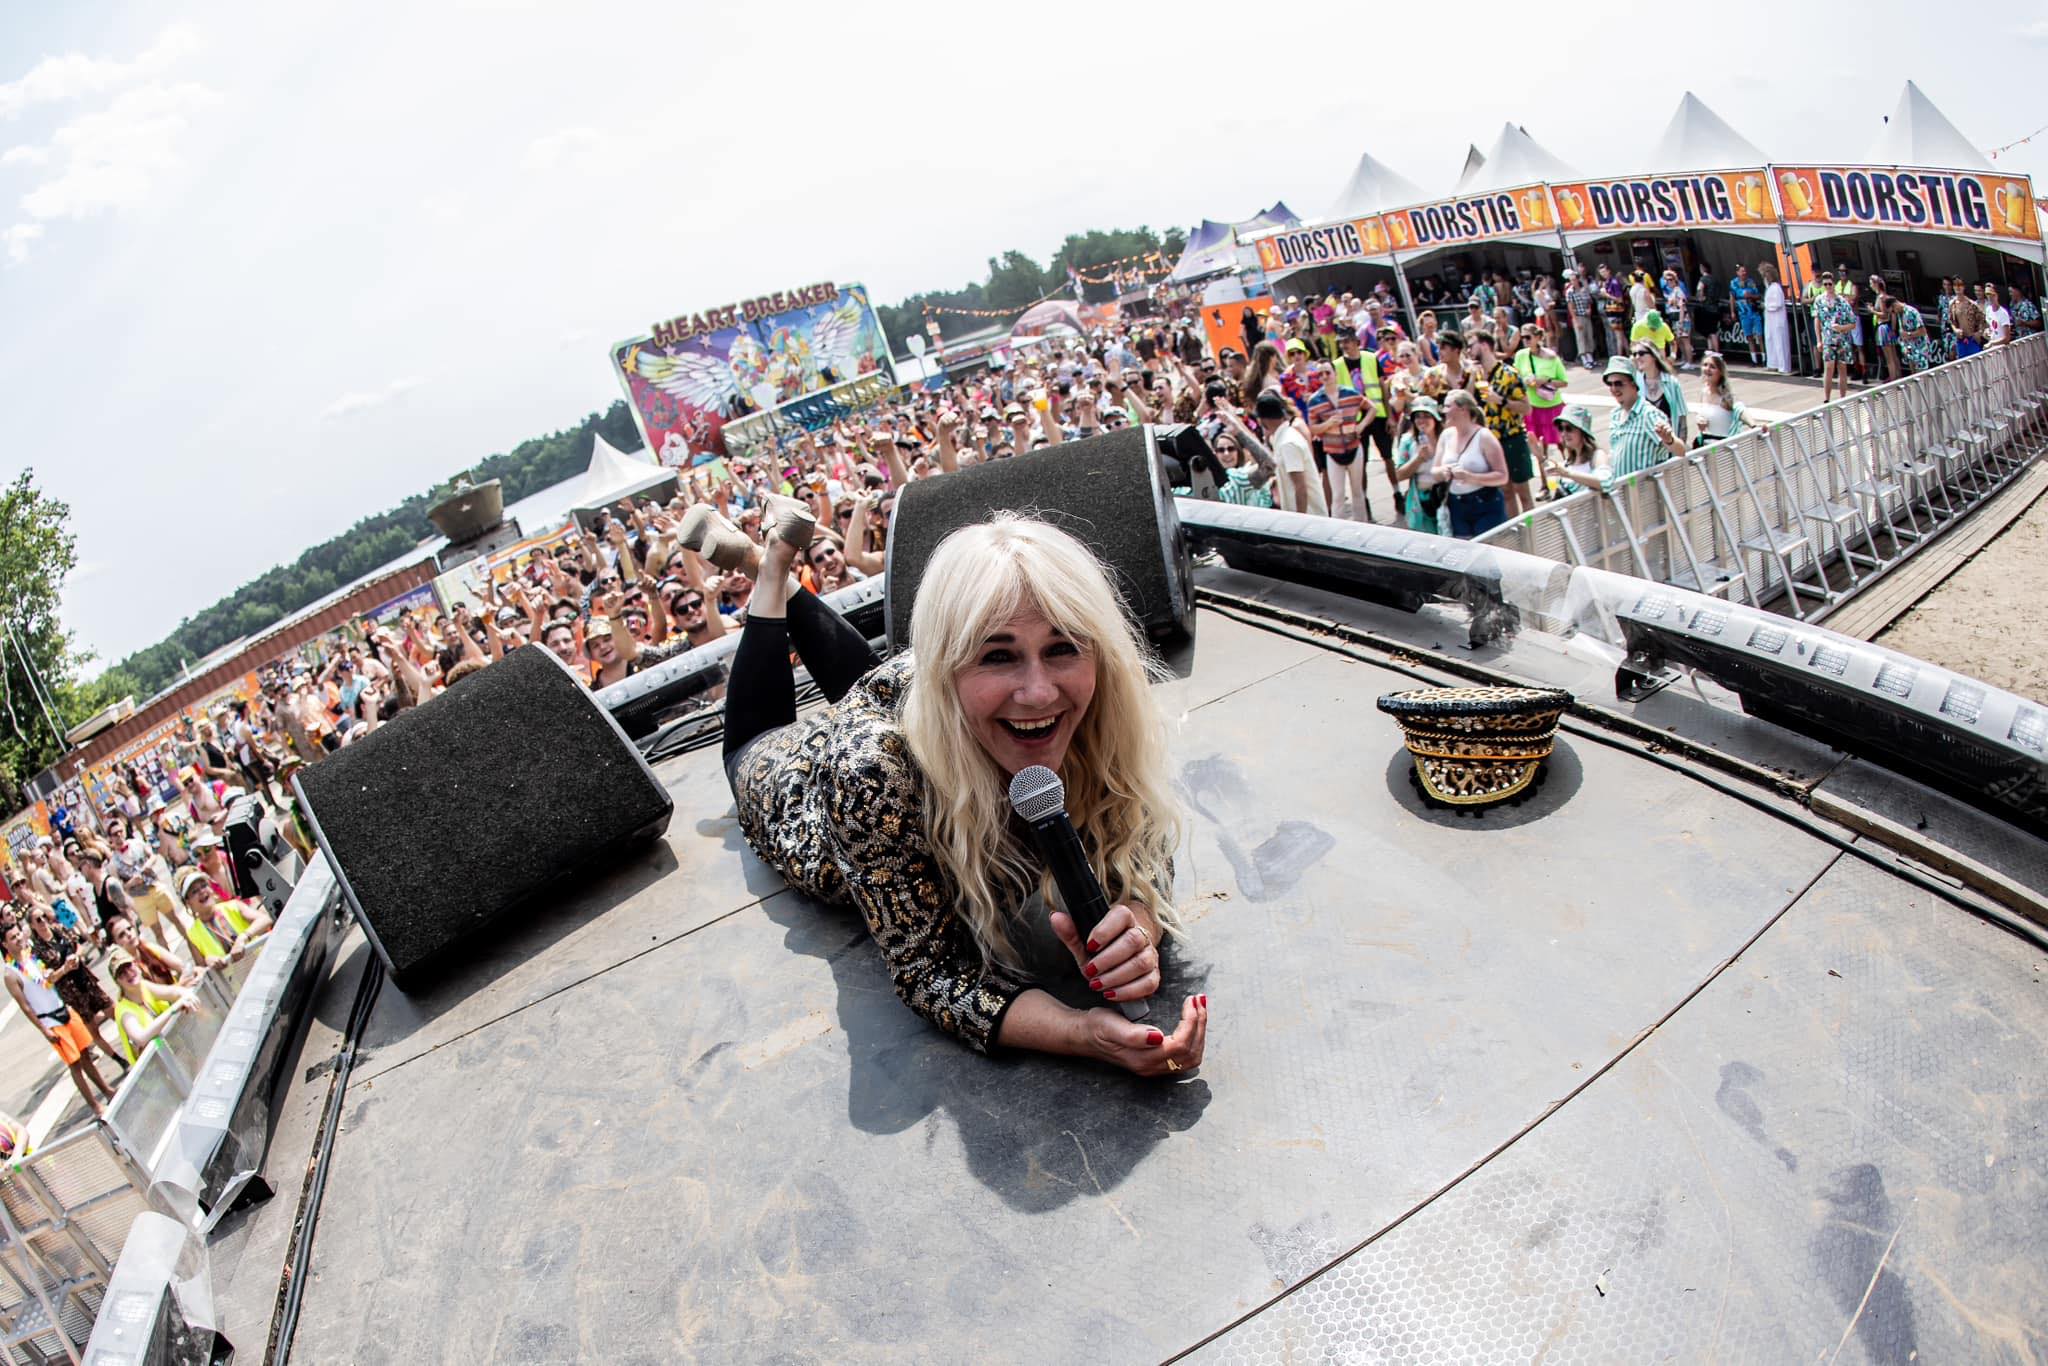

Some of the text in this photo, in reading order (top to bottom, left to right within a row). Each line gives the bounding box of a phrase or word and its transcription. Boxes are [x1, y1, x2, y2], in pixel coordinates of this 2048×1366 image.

[1409, 194, 1520, 244] DORSTIG
[1588, 176, 1733, 224] DORSTIG
[1819, 171, 1990, 230] DORSTIG
[1276, 224, 1362, 265] DORSTIG
[652, 282, 840, 346] HEART BREAKER
